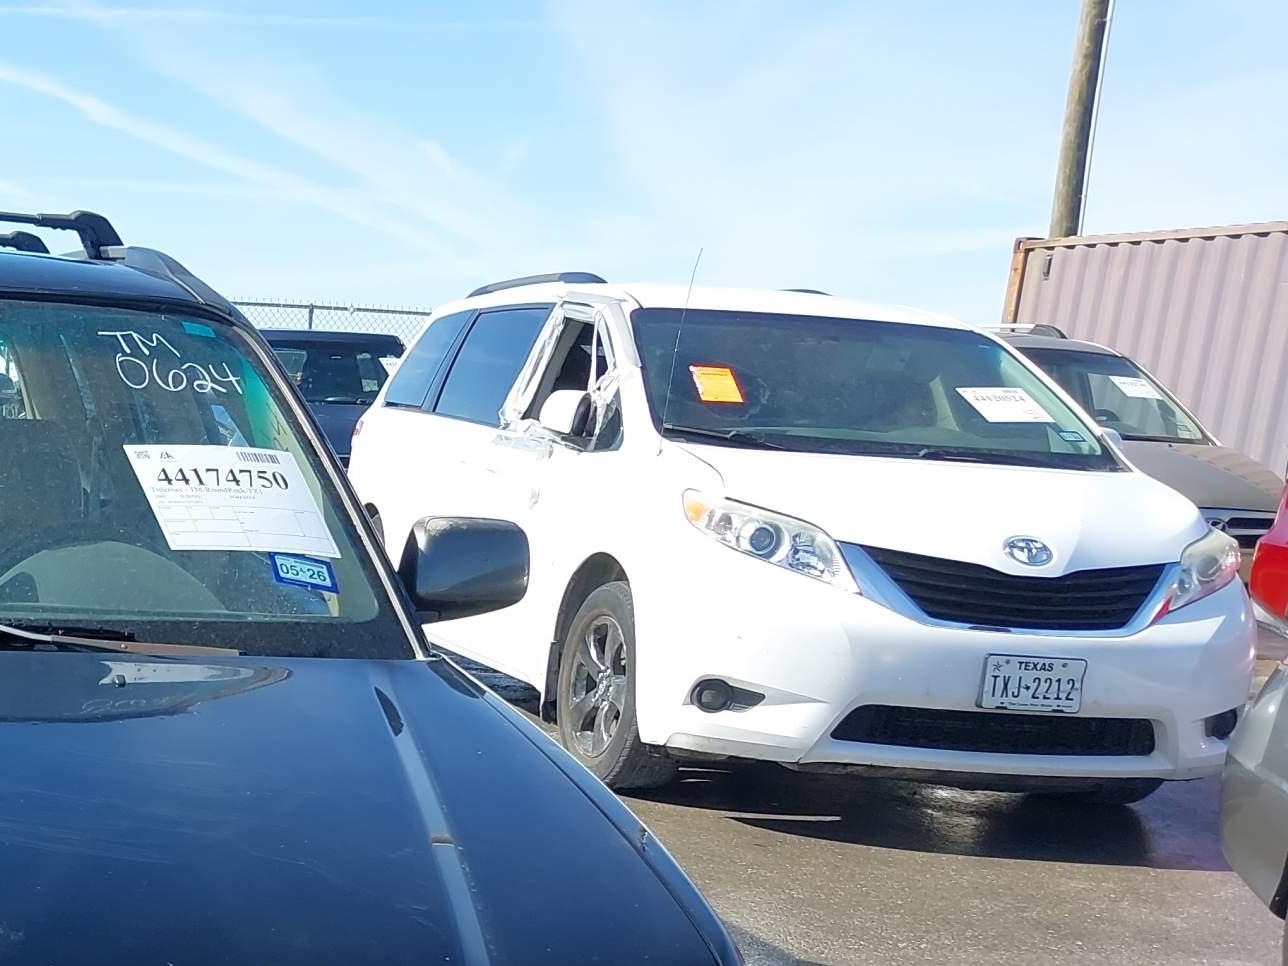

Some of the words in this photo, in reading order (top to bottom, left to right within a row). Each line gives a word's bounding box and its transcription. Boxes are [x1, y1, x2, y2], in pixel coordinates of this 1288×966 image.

[97, 330, 181, 358] TM
[115, 352, 243, 395] 0624
[157, 467, 289, 490] 44174750
[1017, 661, 1054, 672] TEXAS
